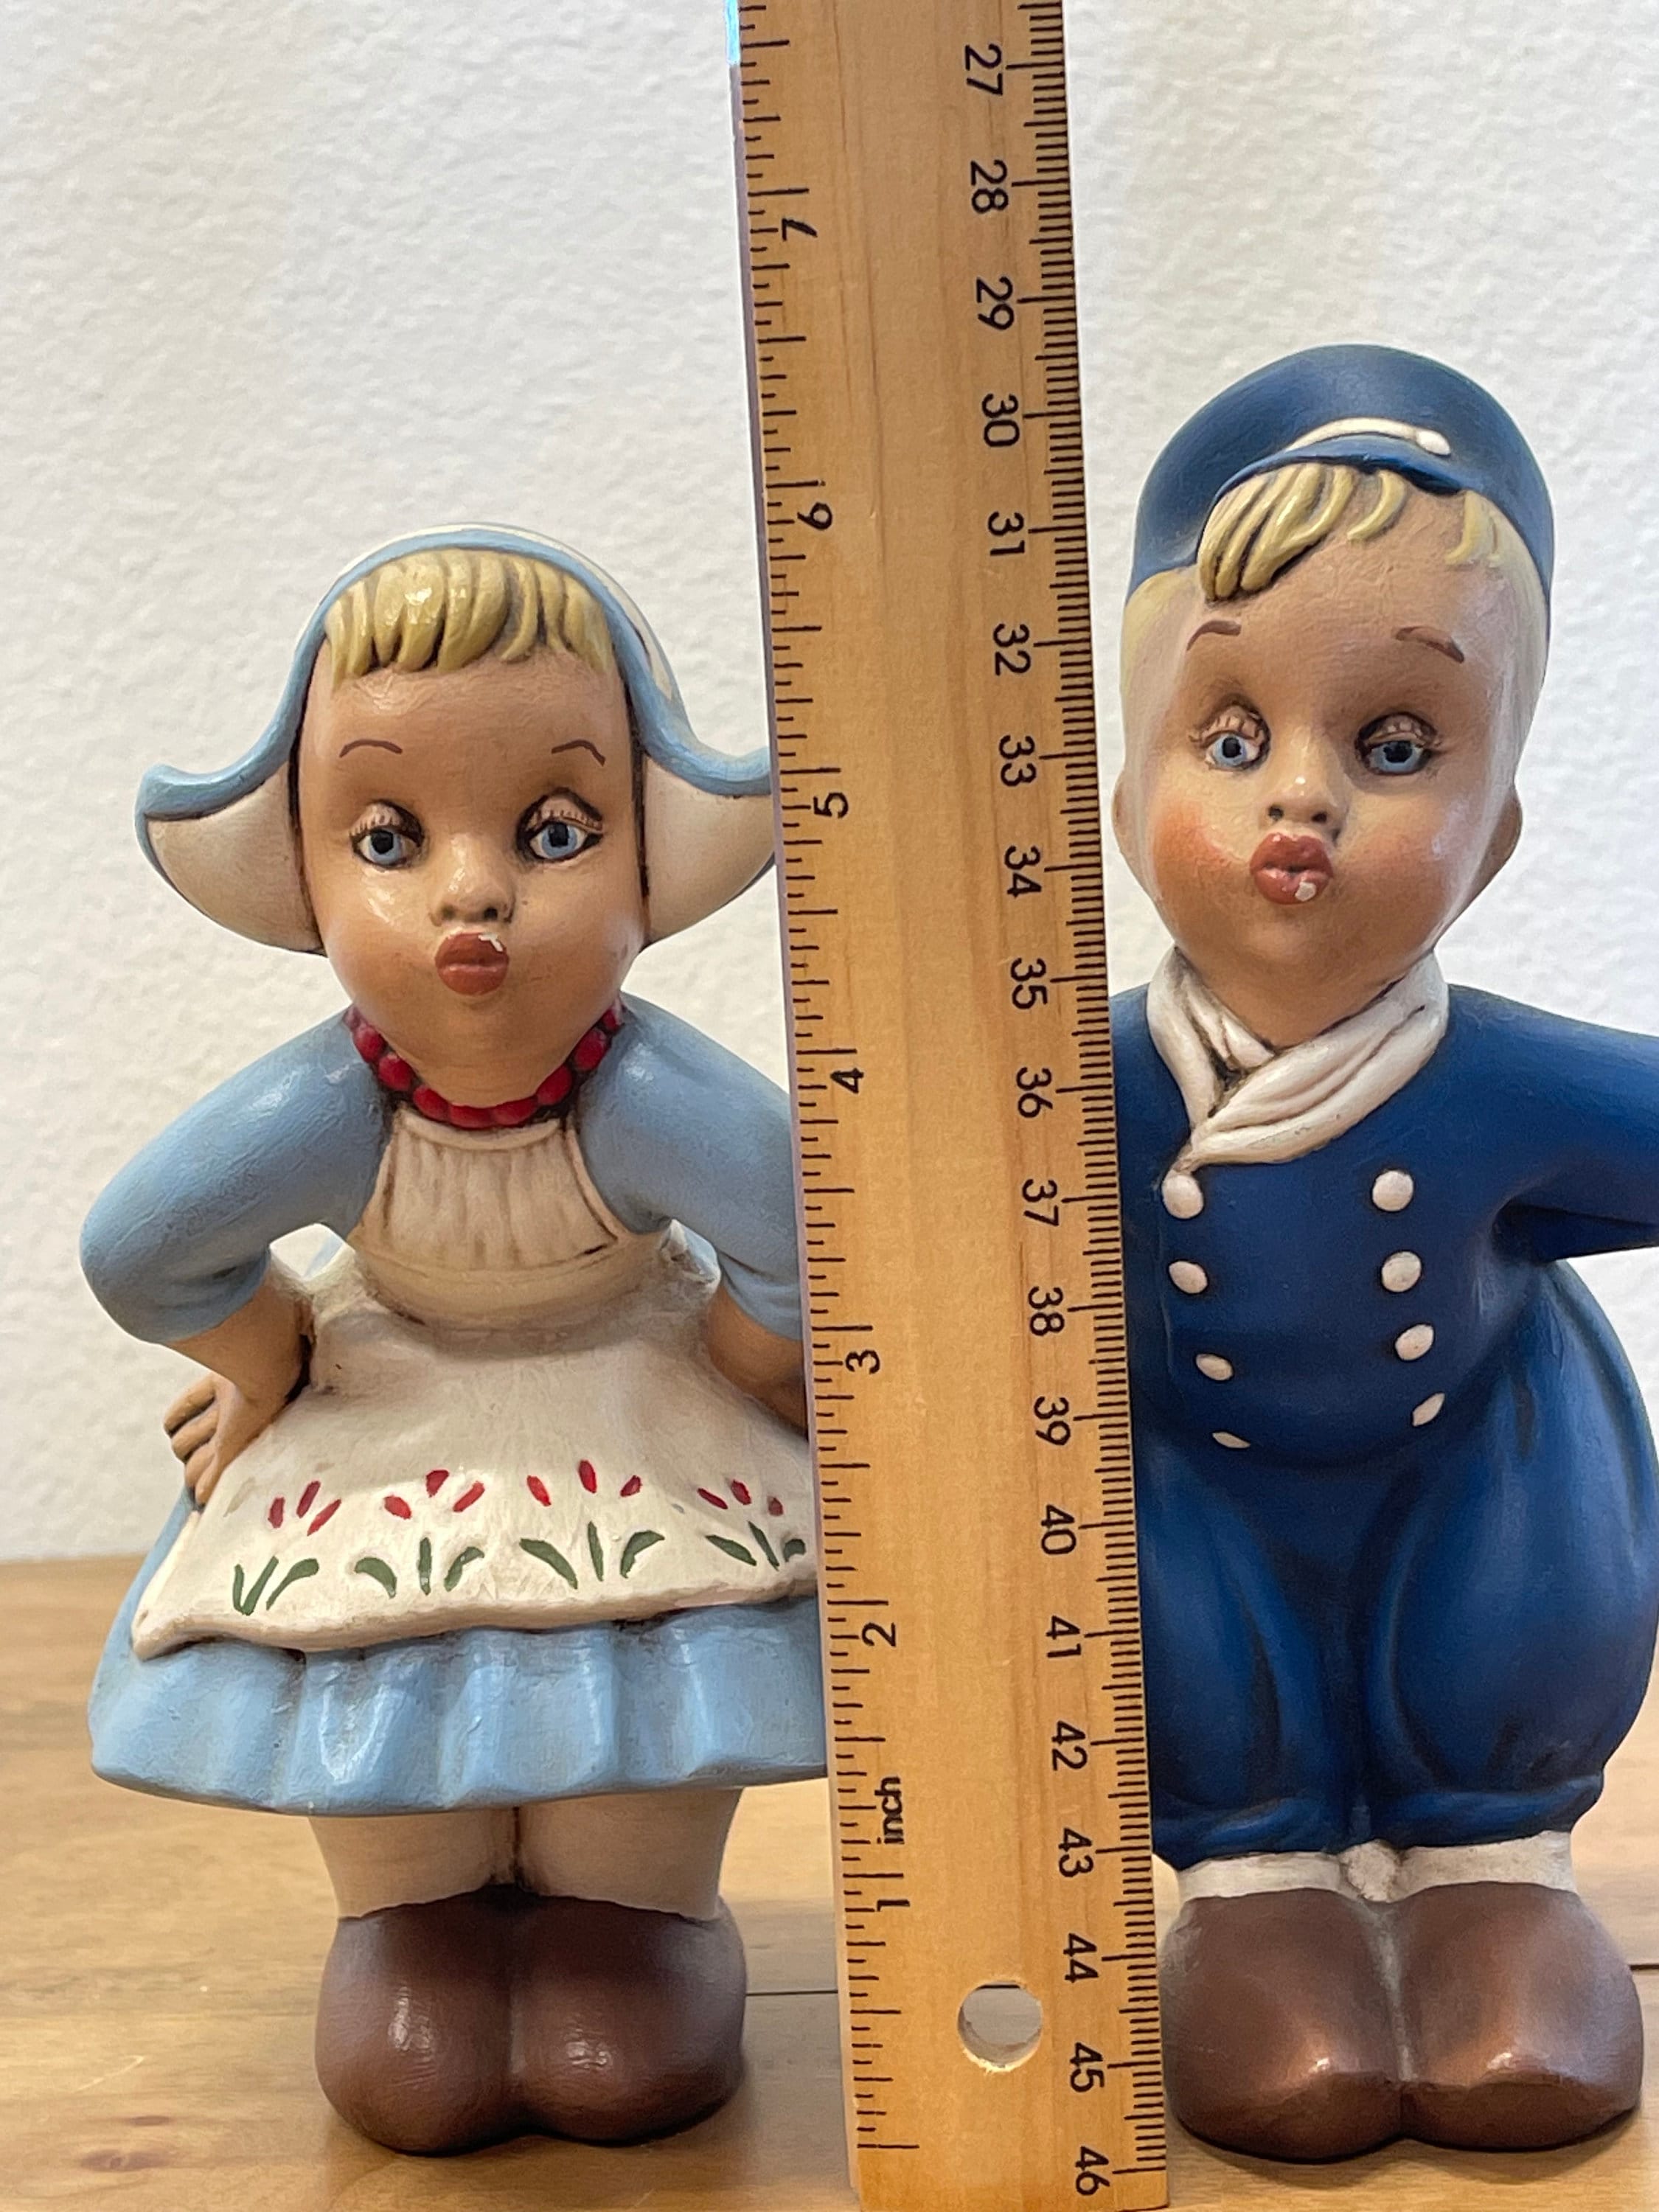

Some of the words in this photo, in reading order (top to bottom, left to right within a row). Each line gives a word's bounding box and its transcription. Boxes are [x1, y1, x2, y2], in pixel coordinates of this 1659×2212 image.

[964, 43, 1004, 97] 27
[970, 159, 1009, 215] 28
[781, 218, 818, 242] 7
[975, 276, 1015, 331] 29
[981, 393, 1020, 448] 30
[796, 502, 833, 531] 6
[987, 511, 1026, 557] 31
[992, 623, 1032, 677] 32
[998, 734, 1037, 787] 33
[813, 792, 849, 819] 5
[1004, 845, 1043, 899] 34
[1010, 957, 1048, 1010] 35
[830, 1067, 864, 1094] 4
[1015, 1066, 1054, 1119] 36
[1021, 1178, 1060, 1227] 37
[1027, 1286, 1065, 1337] 38
[844, 1349, 880, 1374] 3
[1033, 1396, 1071, 1446] 39
[1040, 1504, 1077, 1555] 40
[861, 1622, 897, 1647] 2
[1046, 1615, 1082, 1658] 41
[1051, 1720, 1088, 1772] 42
[874, 1776, 905, 1846] inch
[1058, 1827, 1094, 1878] 43
[876, 1899, 911, 1913] 1
[1062, 1933, 1099, 1983] 44
[1069, 2042, 1105, 2093] 45
[1074, 2146, 1110, 2197] 46
